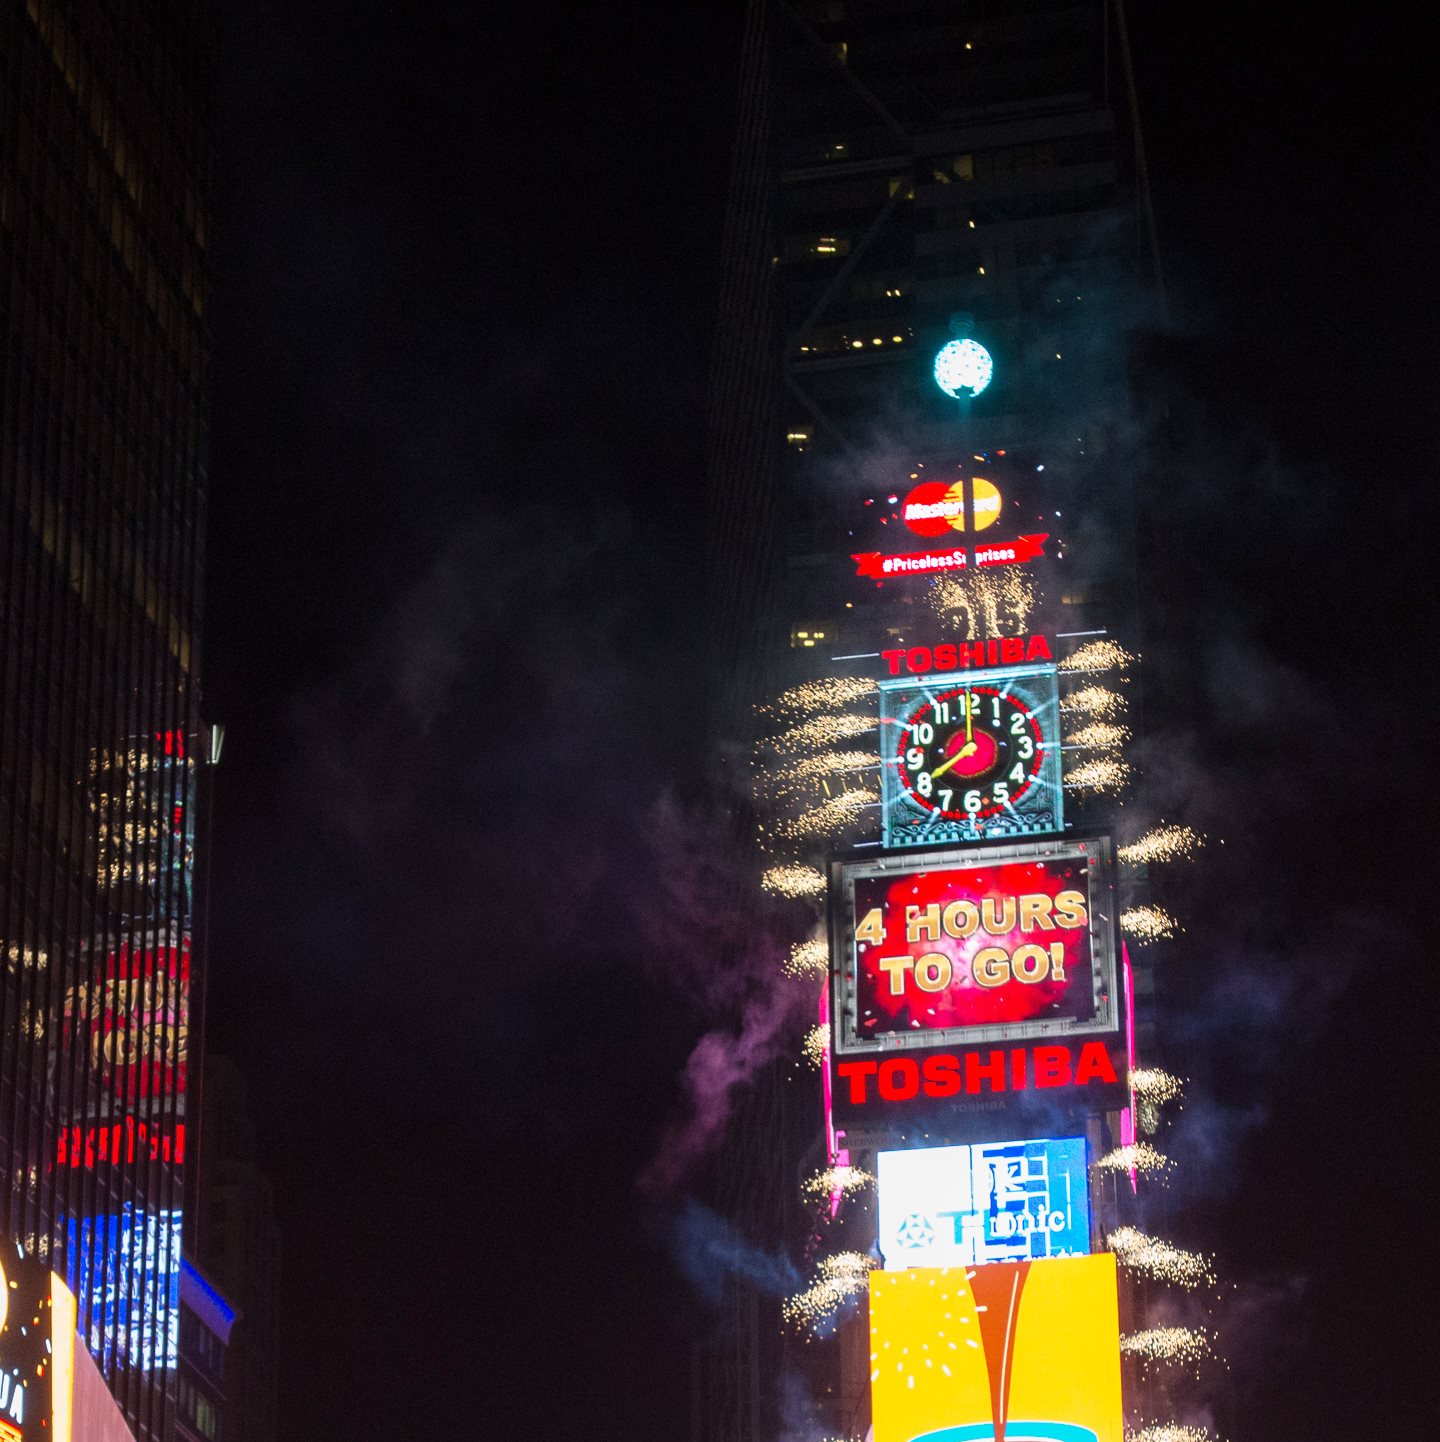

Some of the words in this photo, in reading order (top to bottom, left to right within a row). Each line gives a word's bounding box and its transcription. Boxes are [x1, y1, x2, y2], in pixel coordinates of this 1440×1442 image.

[904, 494, 1000, 522] Masterard
[882, 546, 1016, 575] #PricelessSuprises
[880, 635, 1053, 675] TOSHIBA
[855, 908, 887, 947] 4
[906, 889, 1088, 944] HOURS
[878, 951, 953, 997] TO
[971, 942, 1066, 989] GO!
[837, 1040, 1119, 1105] TOSHIBA
[9, 1384, 24, 1424] A
